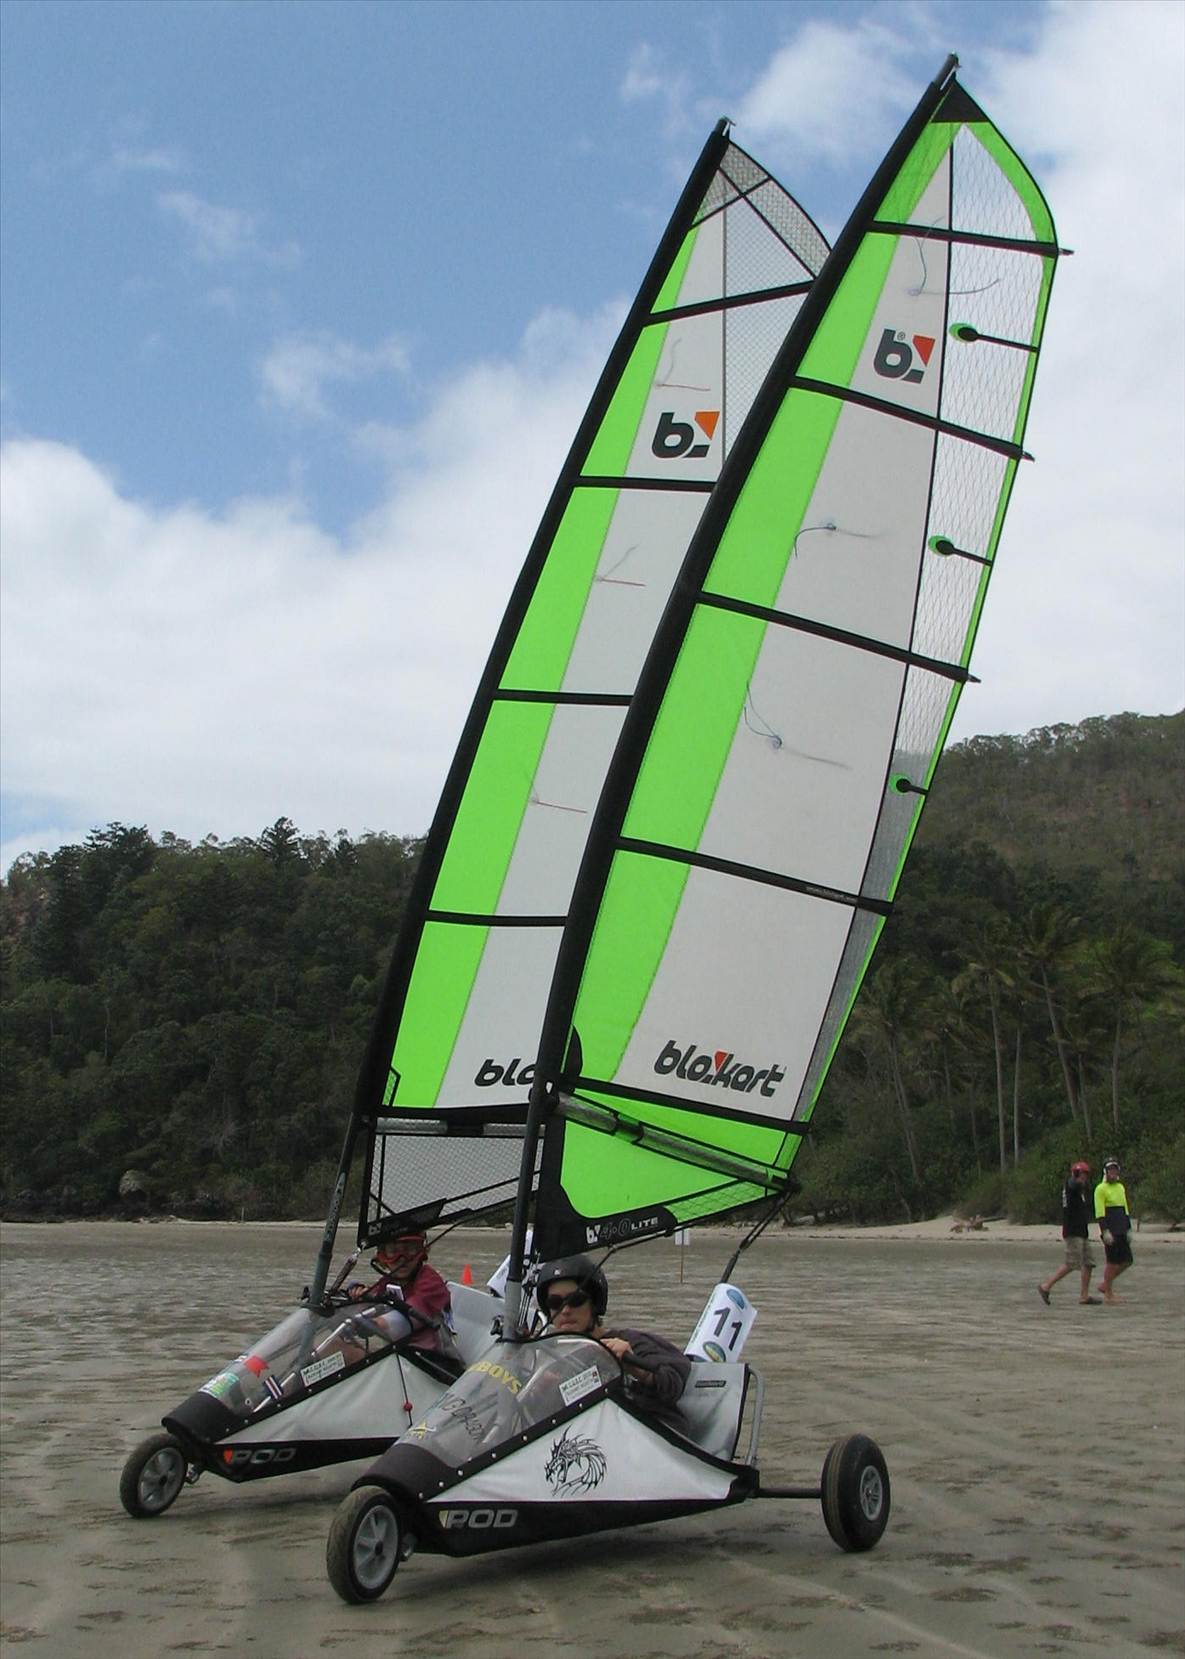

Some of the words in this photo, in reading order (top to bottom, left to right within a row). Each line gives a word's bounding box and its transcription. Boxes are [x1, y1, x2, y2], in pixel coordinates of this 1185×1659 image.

[631, 1217, 659, 1231] LITE
[713, 1306, 743, 1352] 11
[445, 1508, 519, 1529] POD
